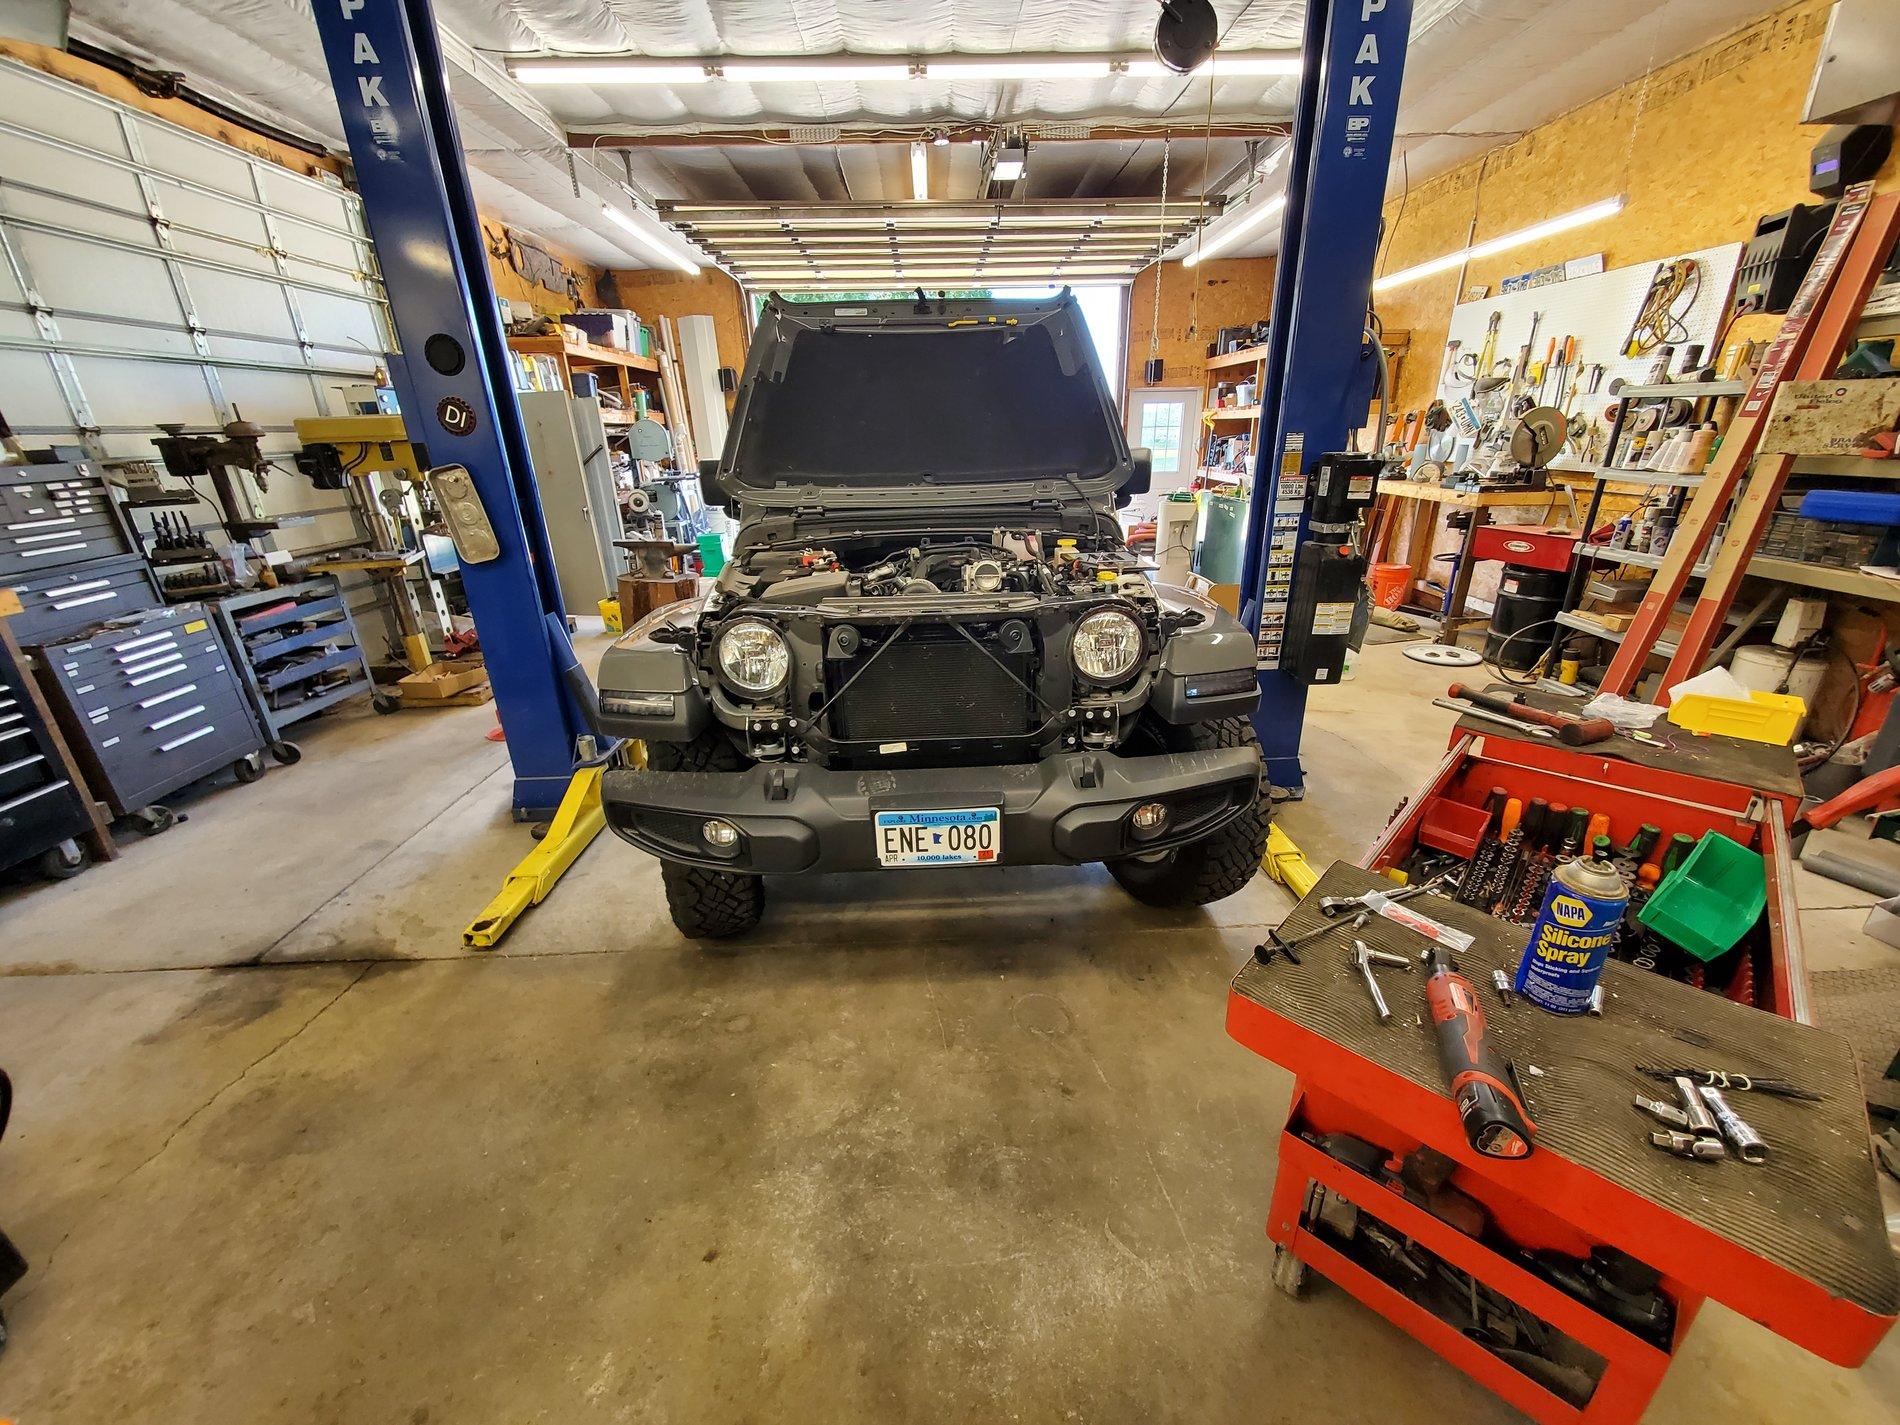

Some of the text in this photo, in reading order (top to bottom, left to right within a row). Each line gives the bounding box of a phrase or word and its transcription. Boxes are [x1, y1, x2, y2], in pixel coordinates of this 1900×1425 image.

[909, 813, 966, 823] Minnesota
[884, 824, 992, 853] ENE 080
[885, 854, 898, 862] APR
[1556, 902, 1585, 921] NAPA
[1541, 924, 1612, 949] Silicone
[1537, 940, 1591, 968] Spray
